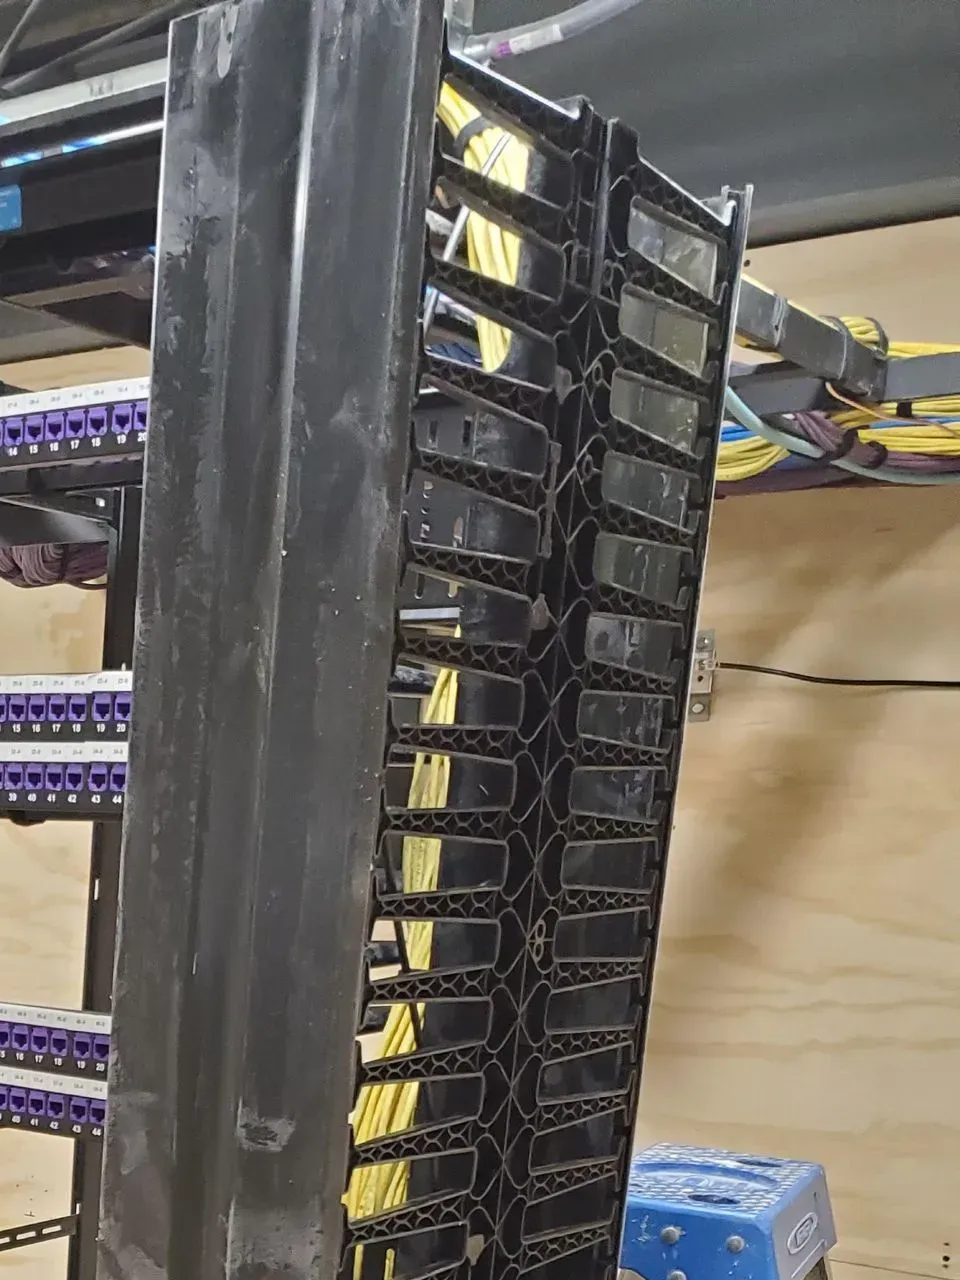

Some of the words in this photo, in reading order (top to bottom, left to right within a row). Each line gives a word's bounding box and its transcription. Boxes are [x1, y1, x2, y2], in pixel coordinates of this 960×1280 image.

[8, 447, 17, 456] 14
[30, 445, 38, 453] 15
[50, 442, 58, 451] 16
[71, 440, 79, 449] 17
[92, 437, 101, 446] 18
[117, 435, 126, 444] 19
[13, 724, 20, 732] 15
[32, 724, 40, 732] 16
[53, 724, 61, 732] 17
[73, 724, 81, 732] 18
[97, 724, 105, 732] 19
[117, 724, 125, 732] 20
